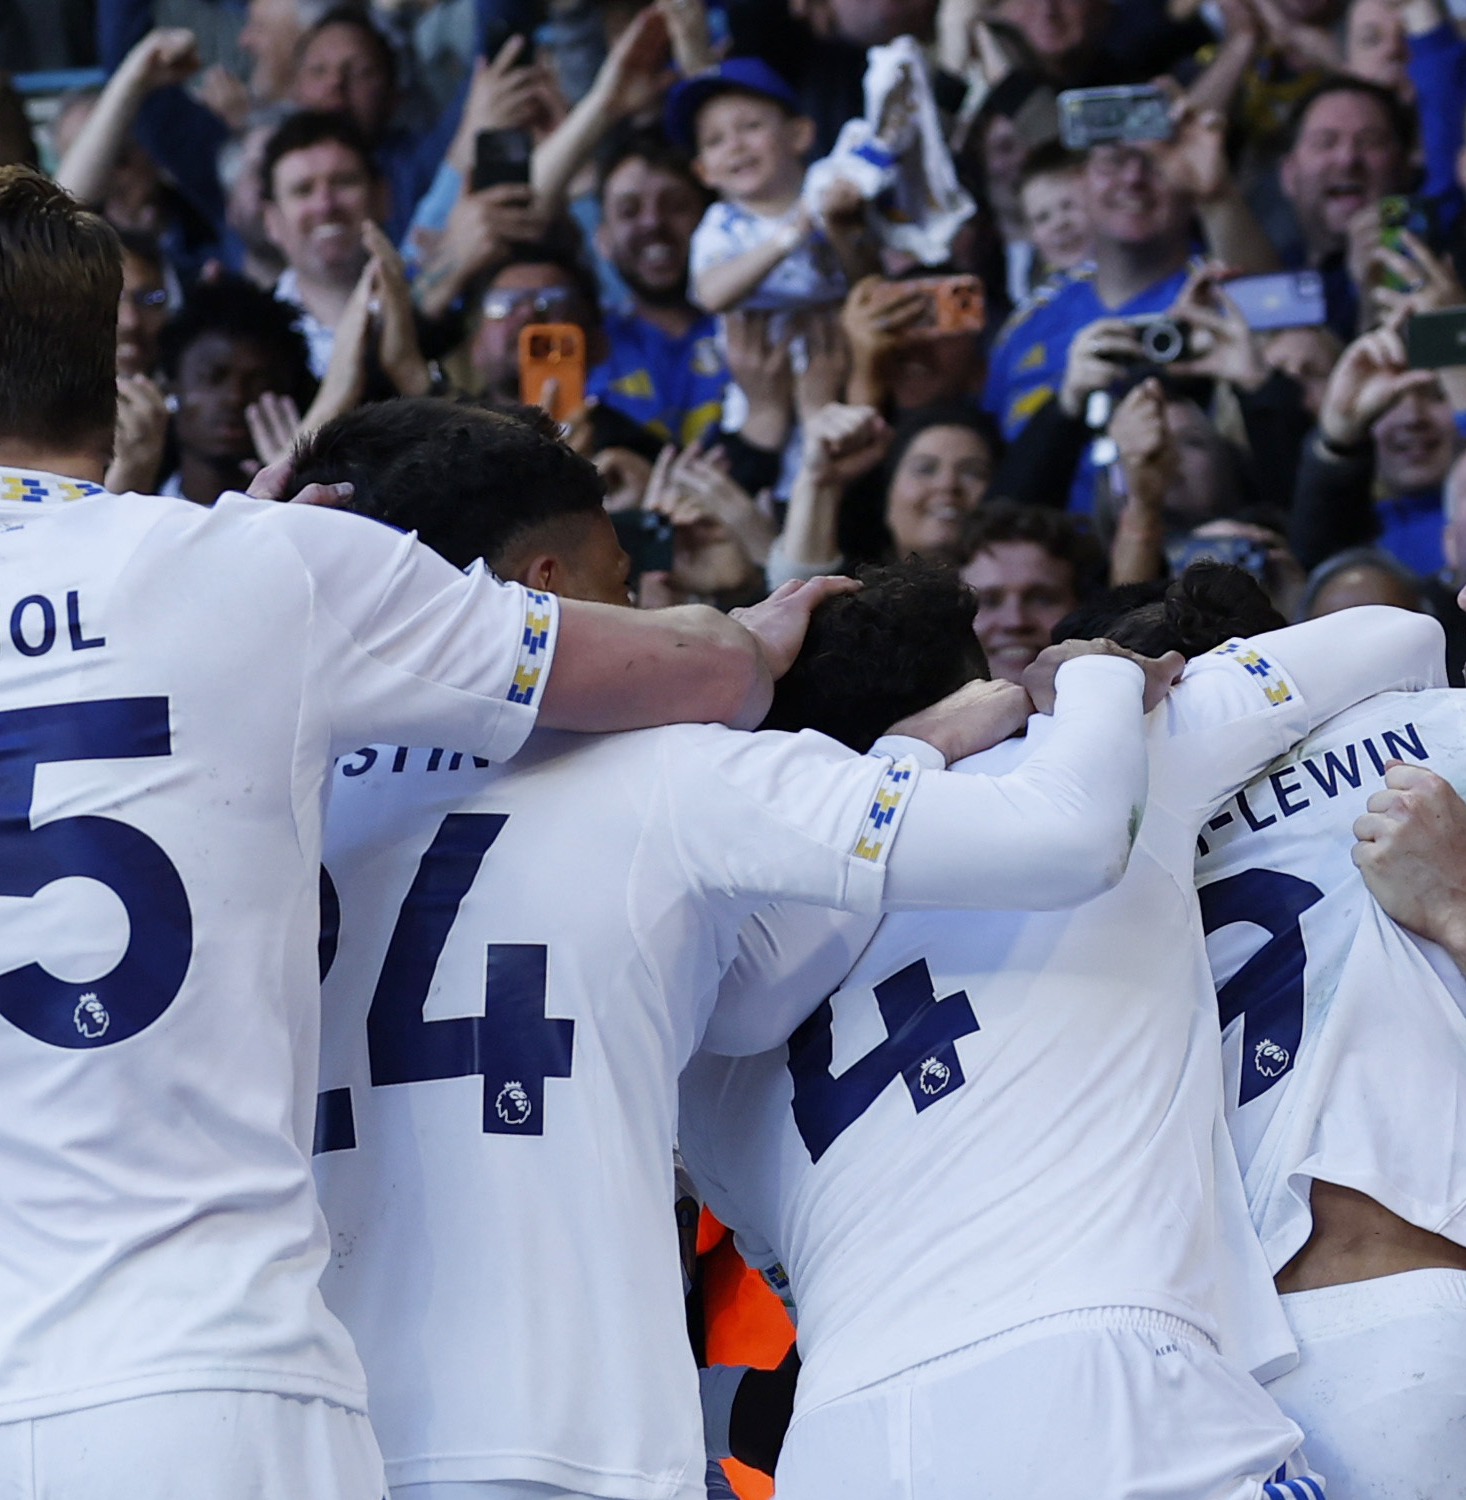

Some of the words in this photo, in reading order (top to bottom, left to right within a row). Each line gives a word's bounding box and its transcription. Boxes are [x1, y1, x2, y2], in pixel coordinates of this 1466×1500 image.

[1196, 722, 1430, 857] -LEWIN
[313, 812, 576, 1157] 4
[787, 956, 981, 1166] 4
